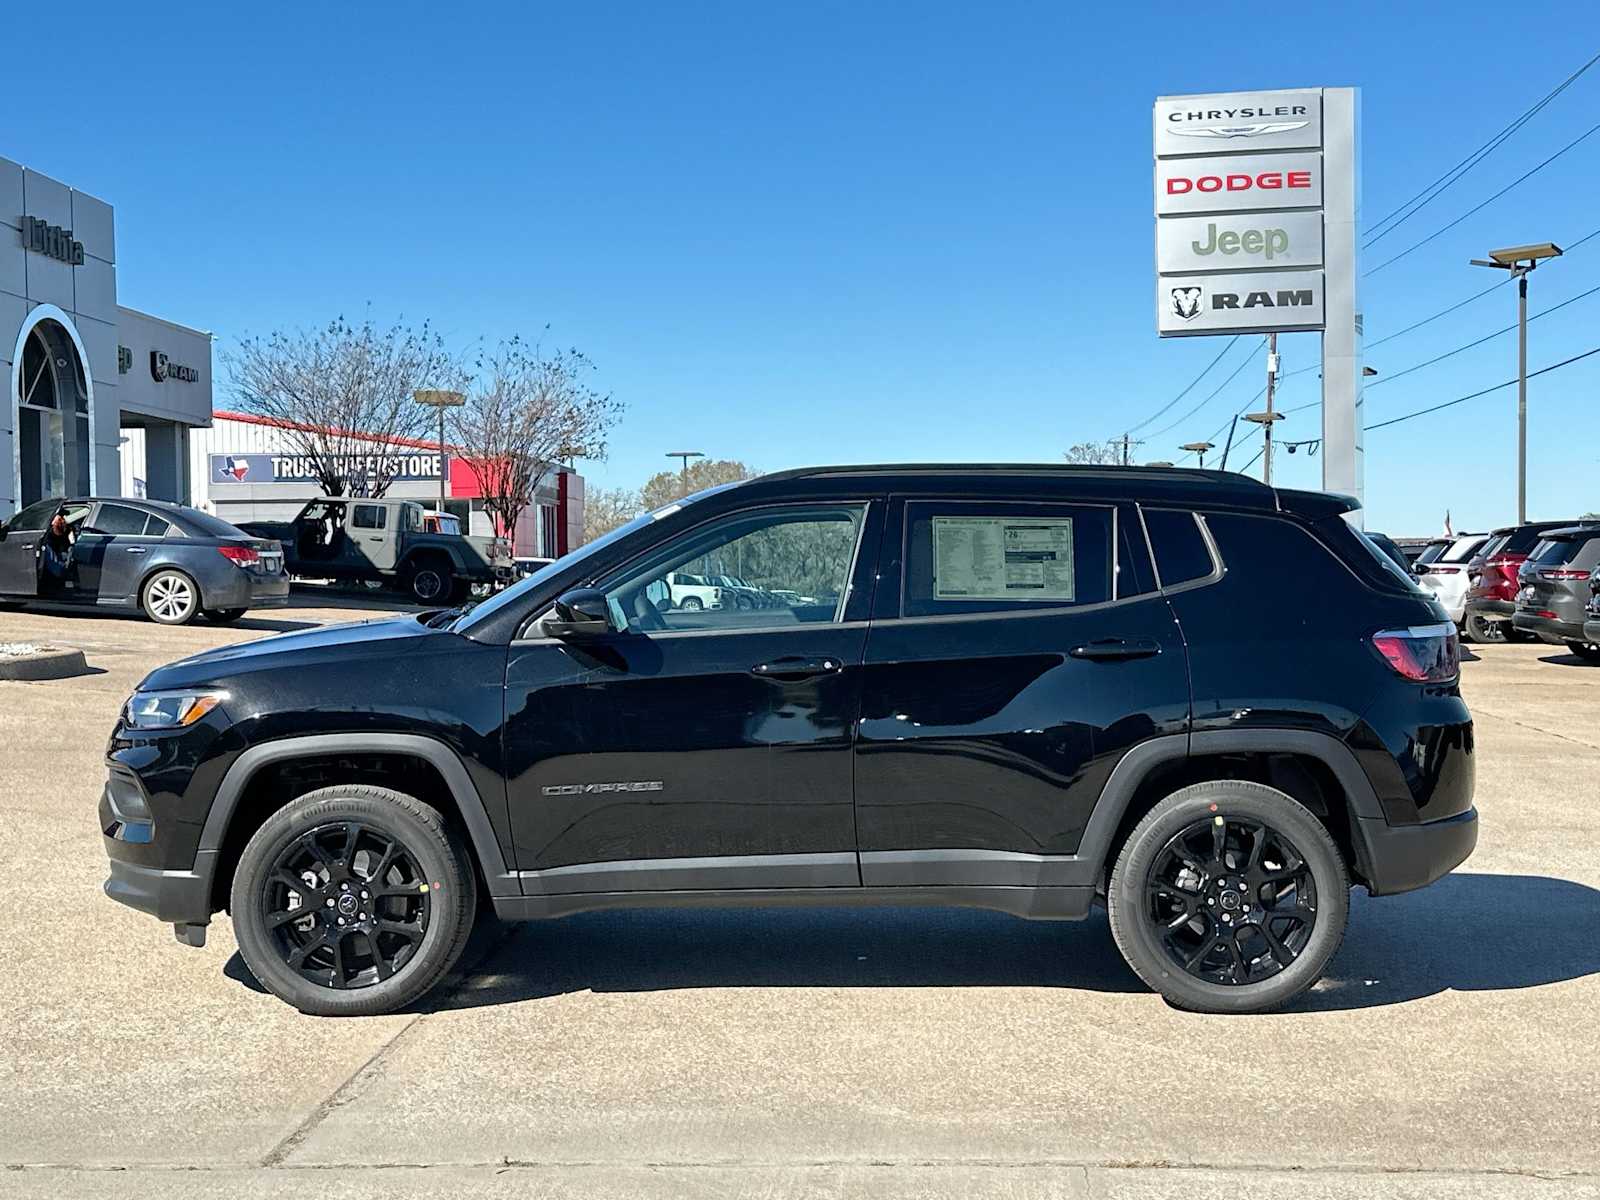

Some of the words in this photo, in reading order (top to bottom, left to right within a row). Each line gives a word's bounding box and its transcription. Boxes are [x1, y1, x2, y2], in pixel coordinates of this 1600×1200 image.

[1168, 105, 1307, 122] CHRYSLER
[1167, 171, 1312, 195] DODGE
[1192, 223, 1289, 260] Jeep
[1212, 290, 1314, 310] RAM
[167, 362, 200, 383] RAM
[541, 781, 663, 795] COMPASS
